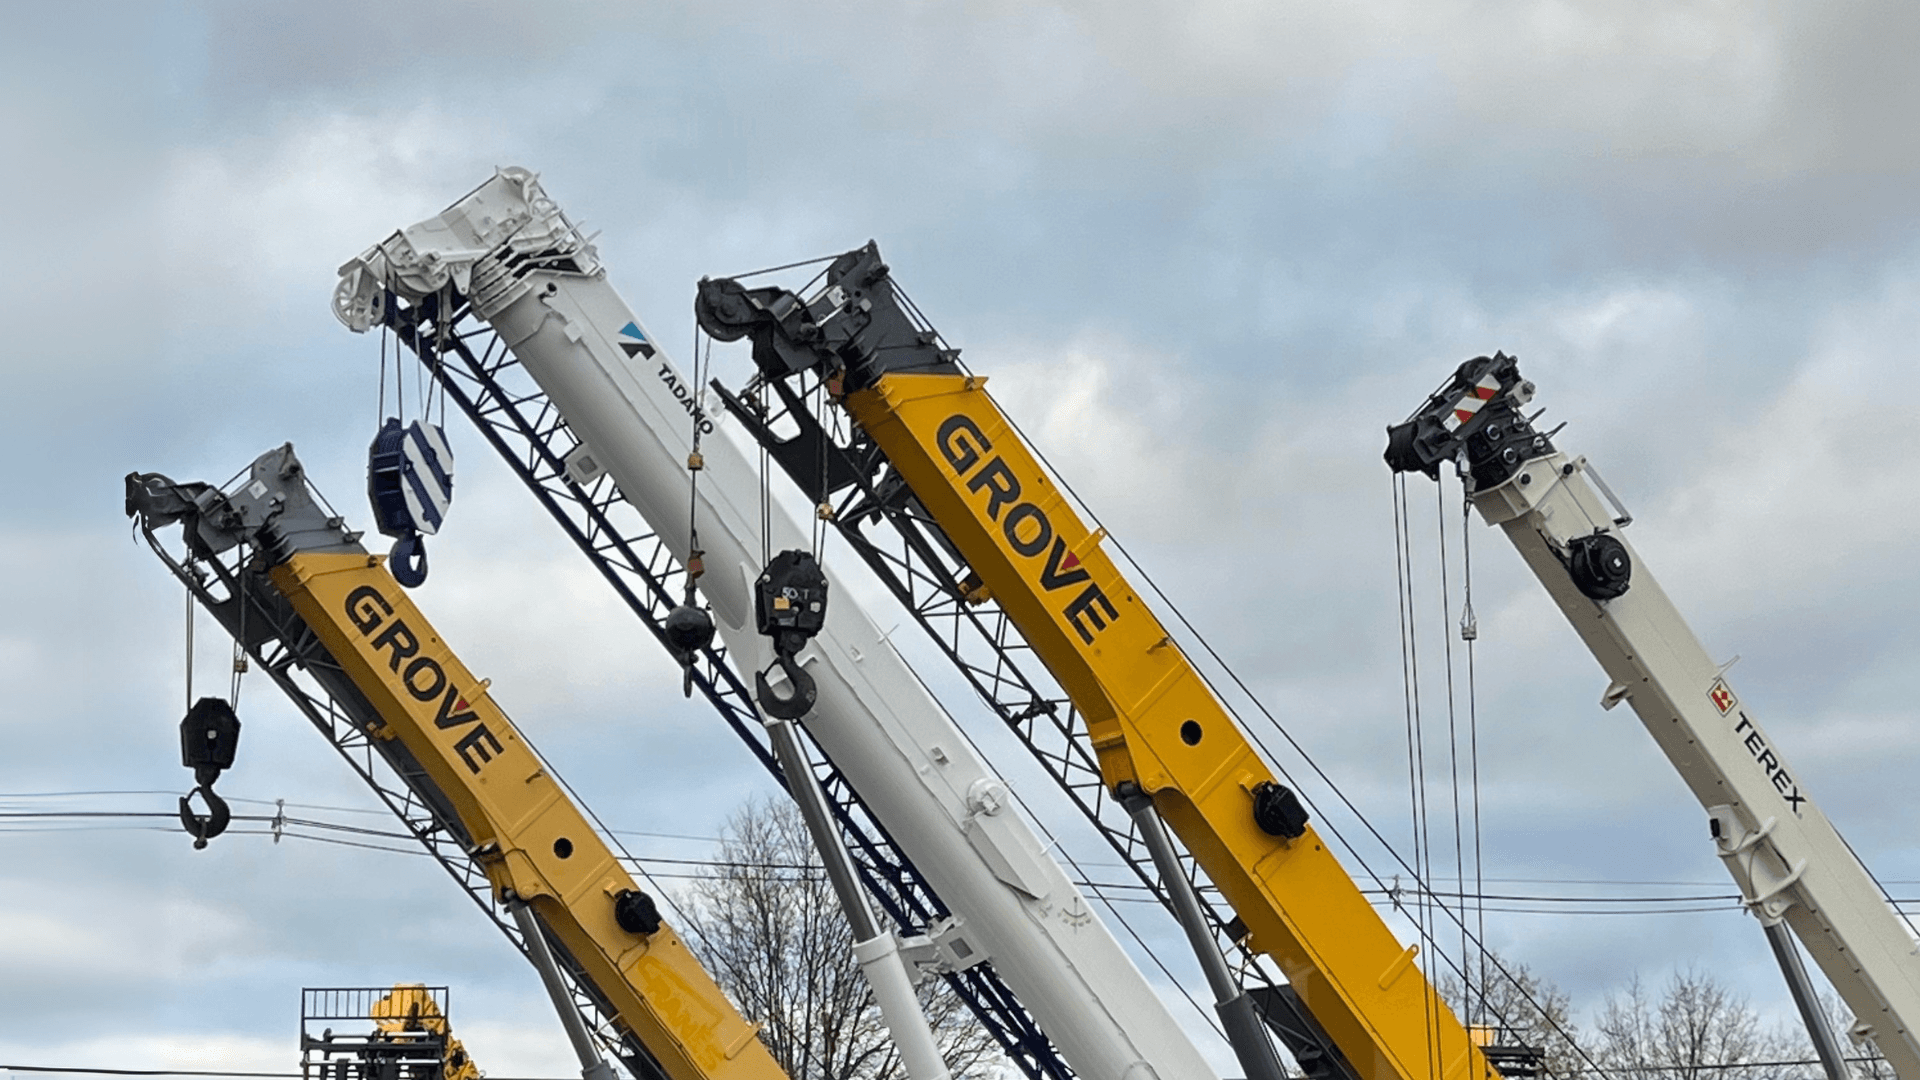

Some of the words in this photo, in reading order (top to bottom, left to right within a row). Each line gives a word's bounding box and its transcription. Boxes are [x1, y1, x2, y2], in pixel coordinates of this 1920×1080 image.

[936, 413, 1120, 646] GROVE
[344, 585, 505, 775] GROVE
[1734, 710, 1807, 814] TEREX
